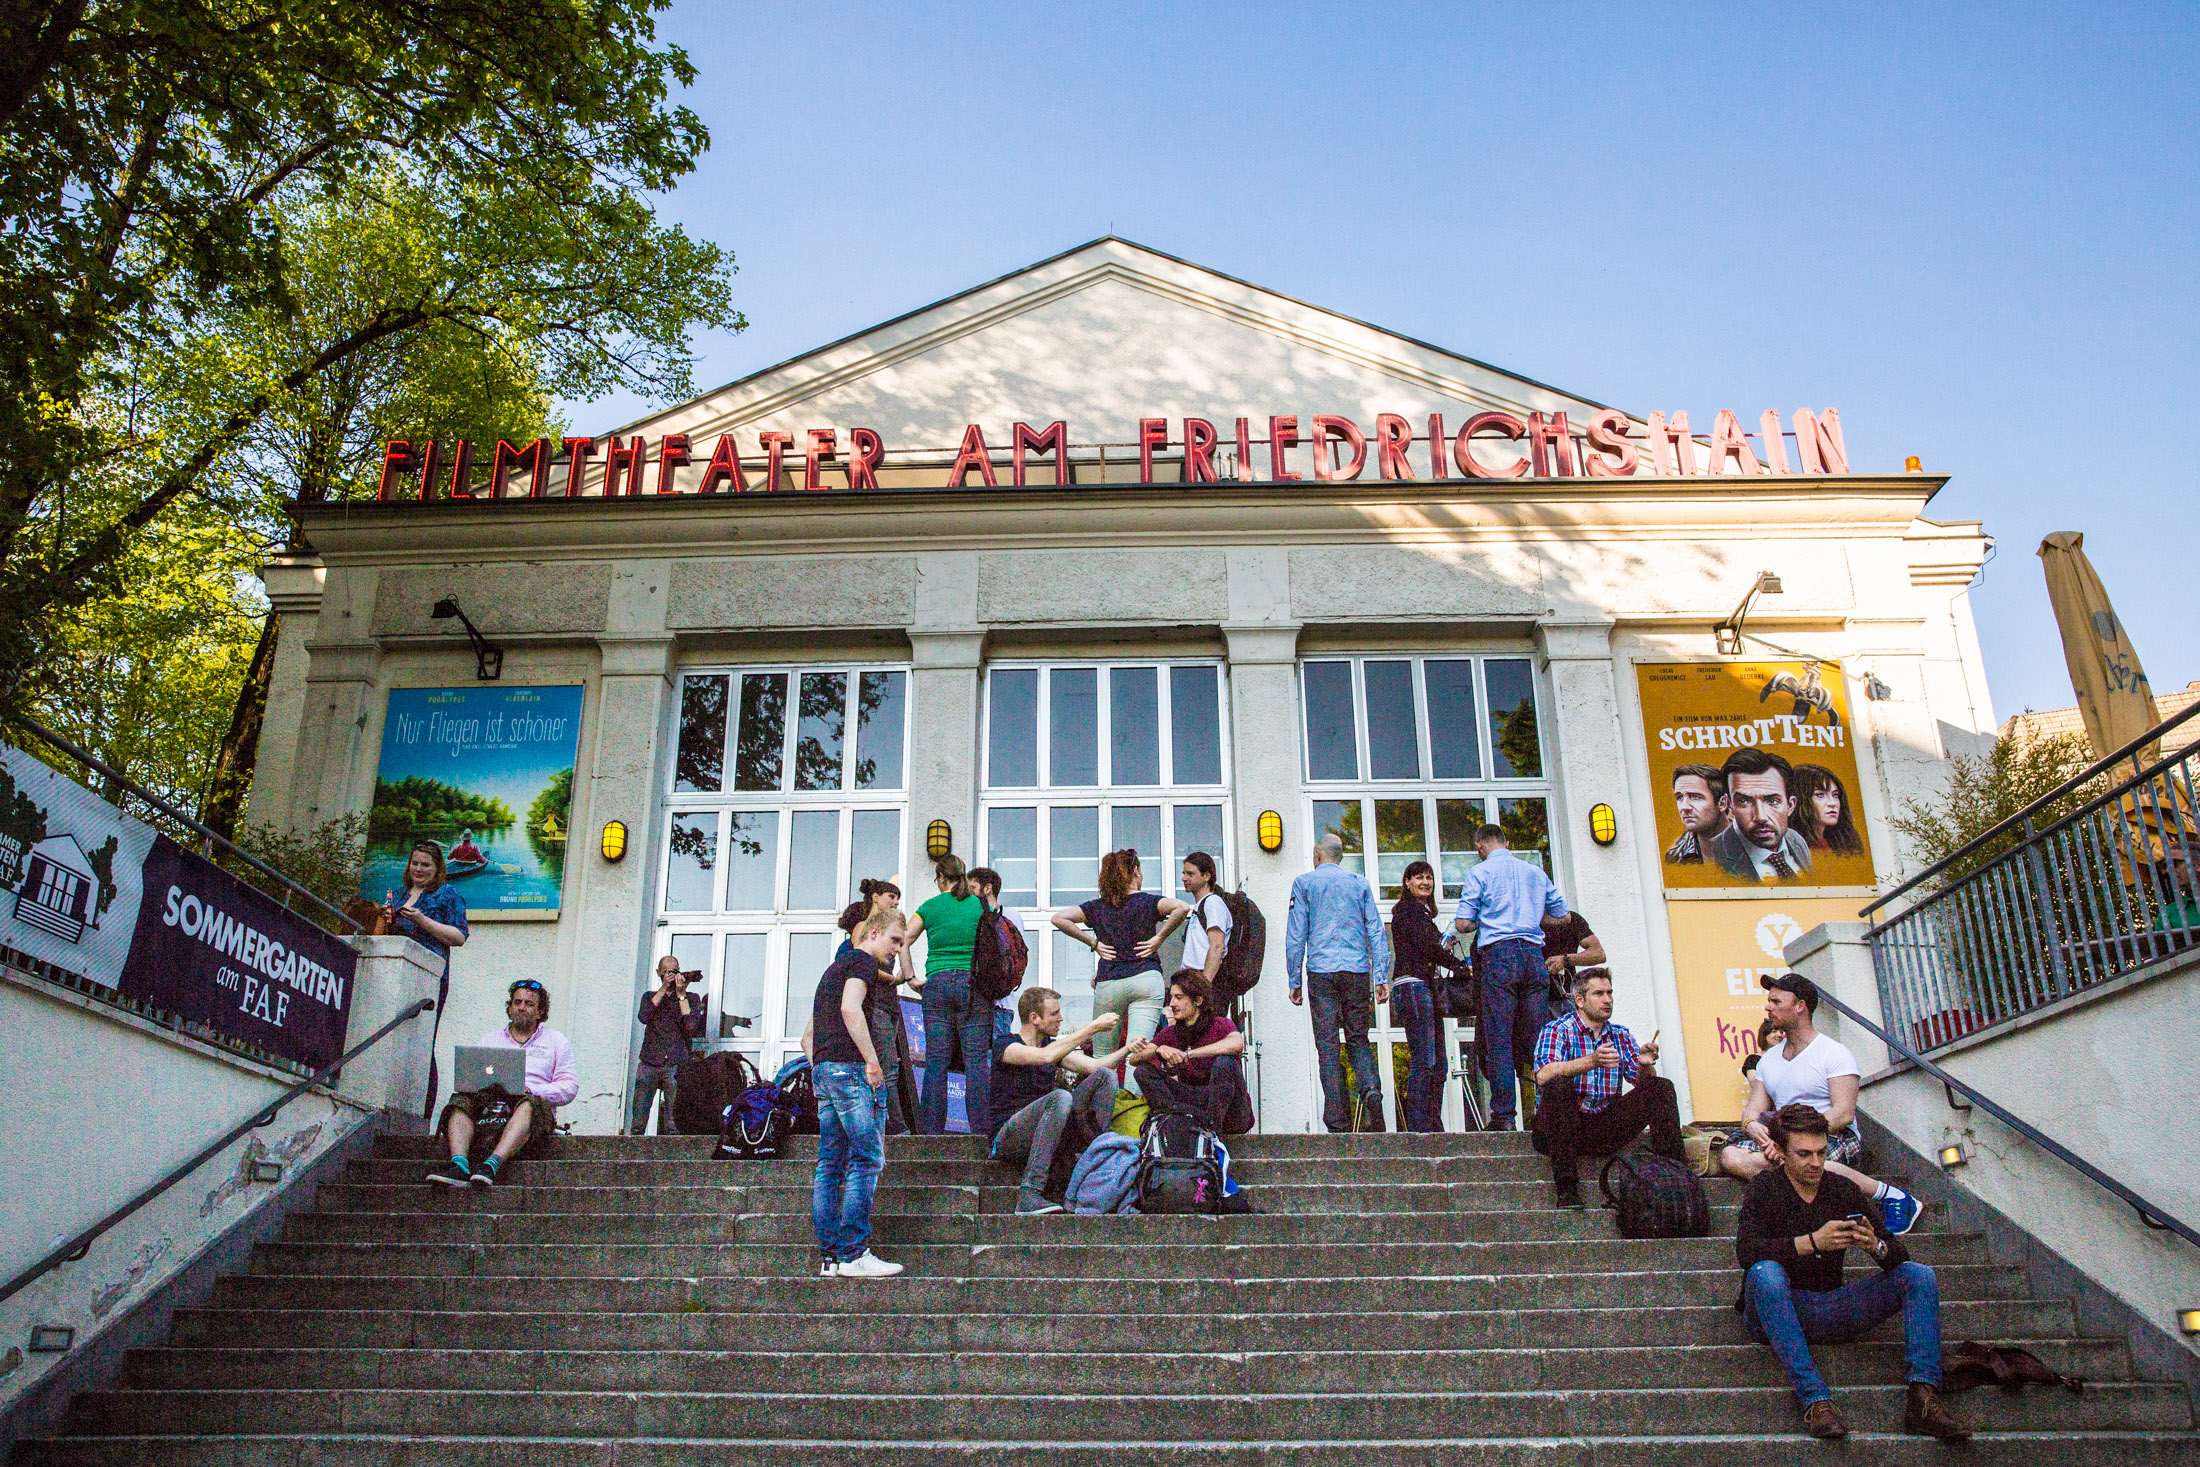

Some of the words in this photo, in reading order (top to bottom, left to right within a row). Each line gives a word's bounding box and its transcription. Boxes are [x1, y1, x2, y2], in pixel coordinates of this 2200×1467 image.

[377, 427, 887, 501] FILMTHEATER
[947, 420, 1068, 487] AM
[1139, 406, 1850, 483] FRIEDRICHSHAIN
[396, 712, 425, 744] Nur
[429, 711, 479, 758] Fliegen
[485, 711, 504, 743] ist
[510, 710, 568, 742] schöner
[1659, 715, 1845, 751] SCHROTTEN!
[1673, 715, 1683, 723] EIN
[162, 885, 345, 1010] SOMMERGARTEN
[216, 964, 239, 992] am
[239, 975, 290, 1028] FAF
